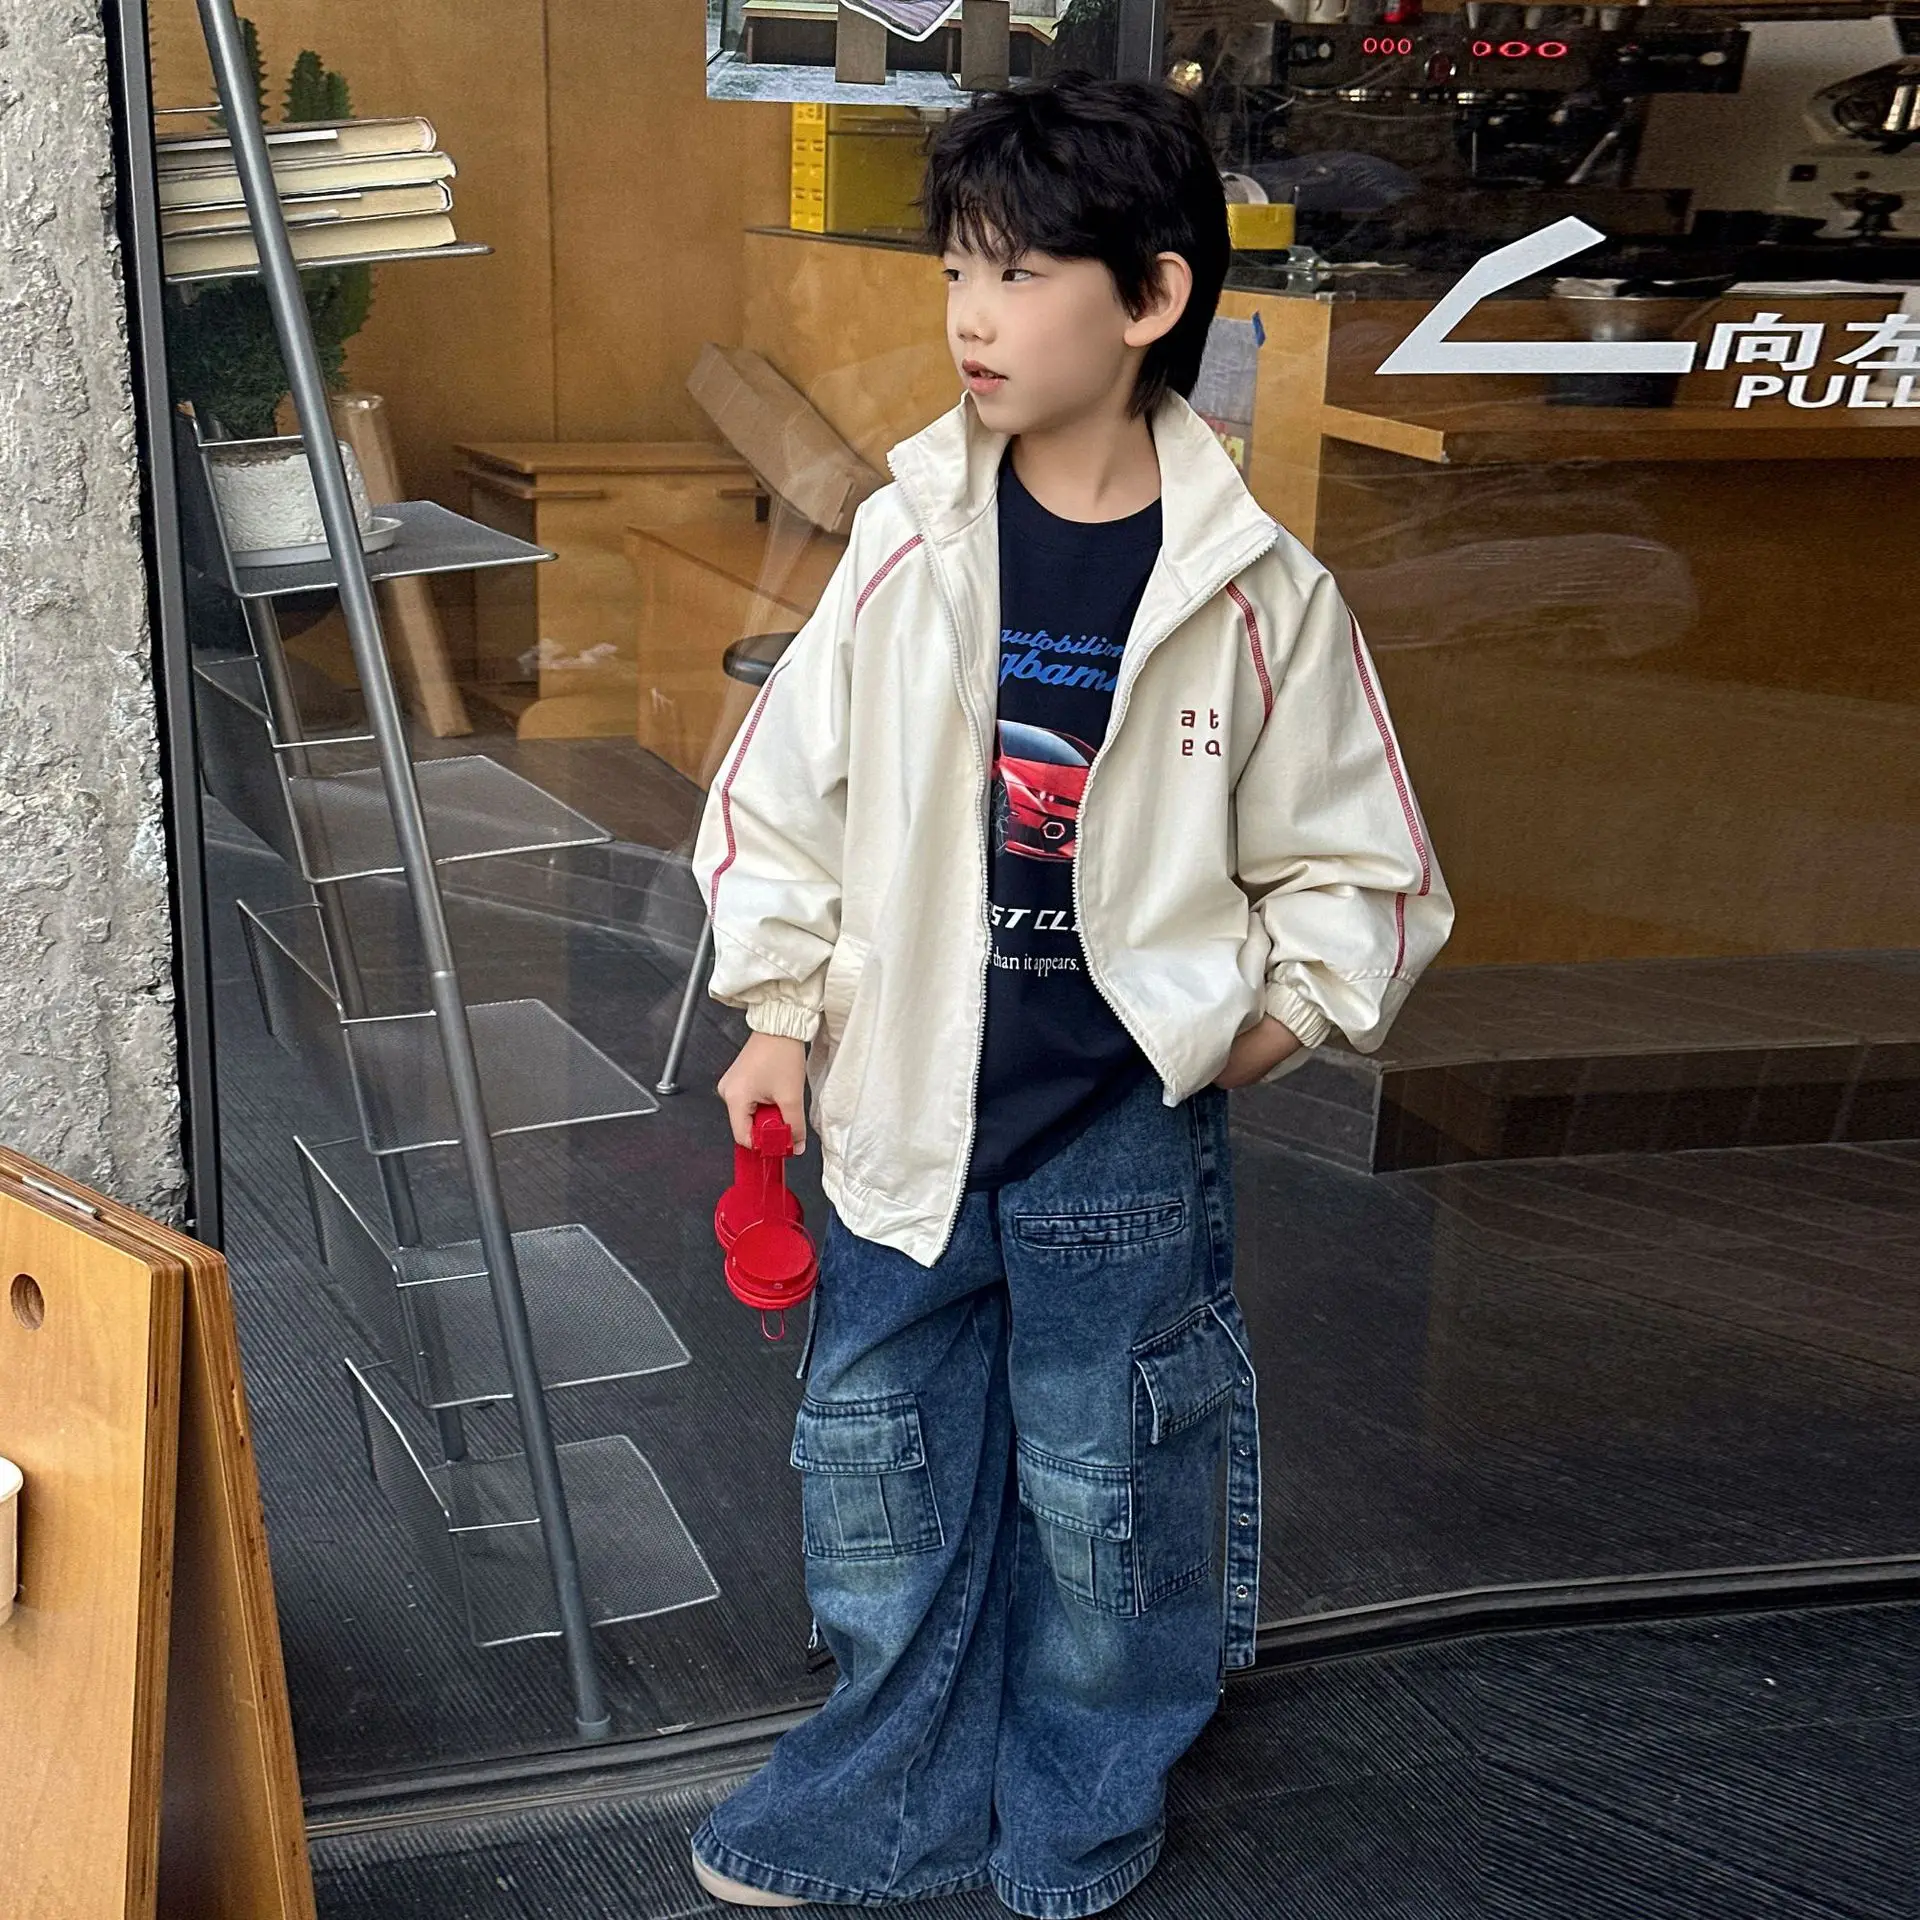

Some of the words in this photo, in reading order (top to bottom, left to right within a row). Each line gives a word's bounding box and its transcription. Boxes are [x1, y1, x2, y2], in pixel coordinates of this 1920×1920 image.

[1734, 375, 1920, 408] PULL
[988, 901, 1031, 928] ST
[993, 946, 1020, 970] than
[1024, 953, 1033, 970] it
[1034, 957, 1080, 977] appears.
